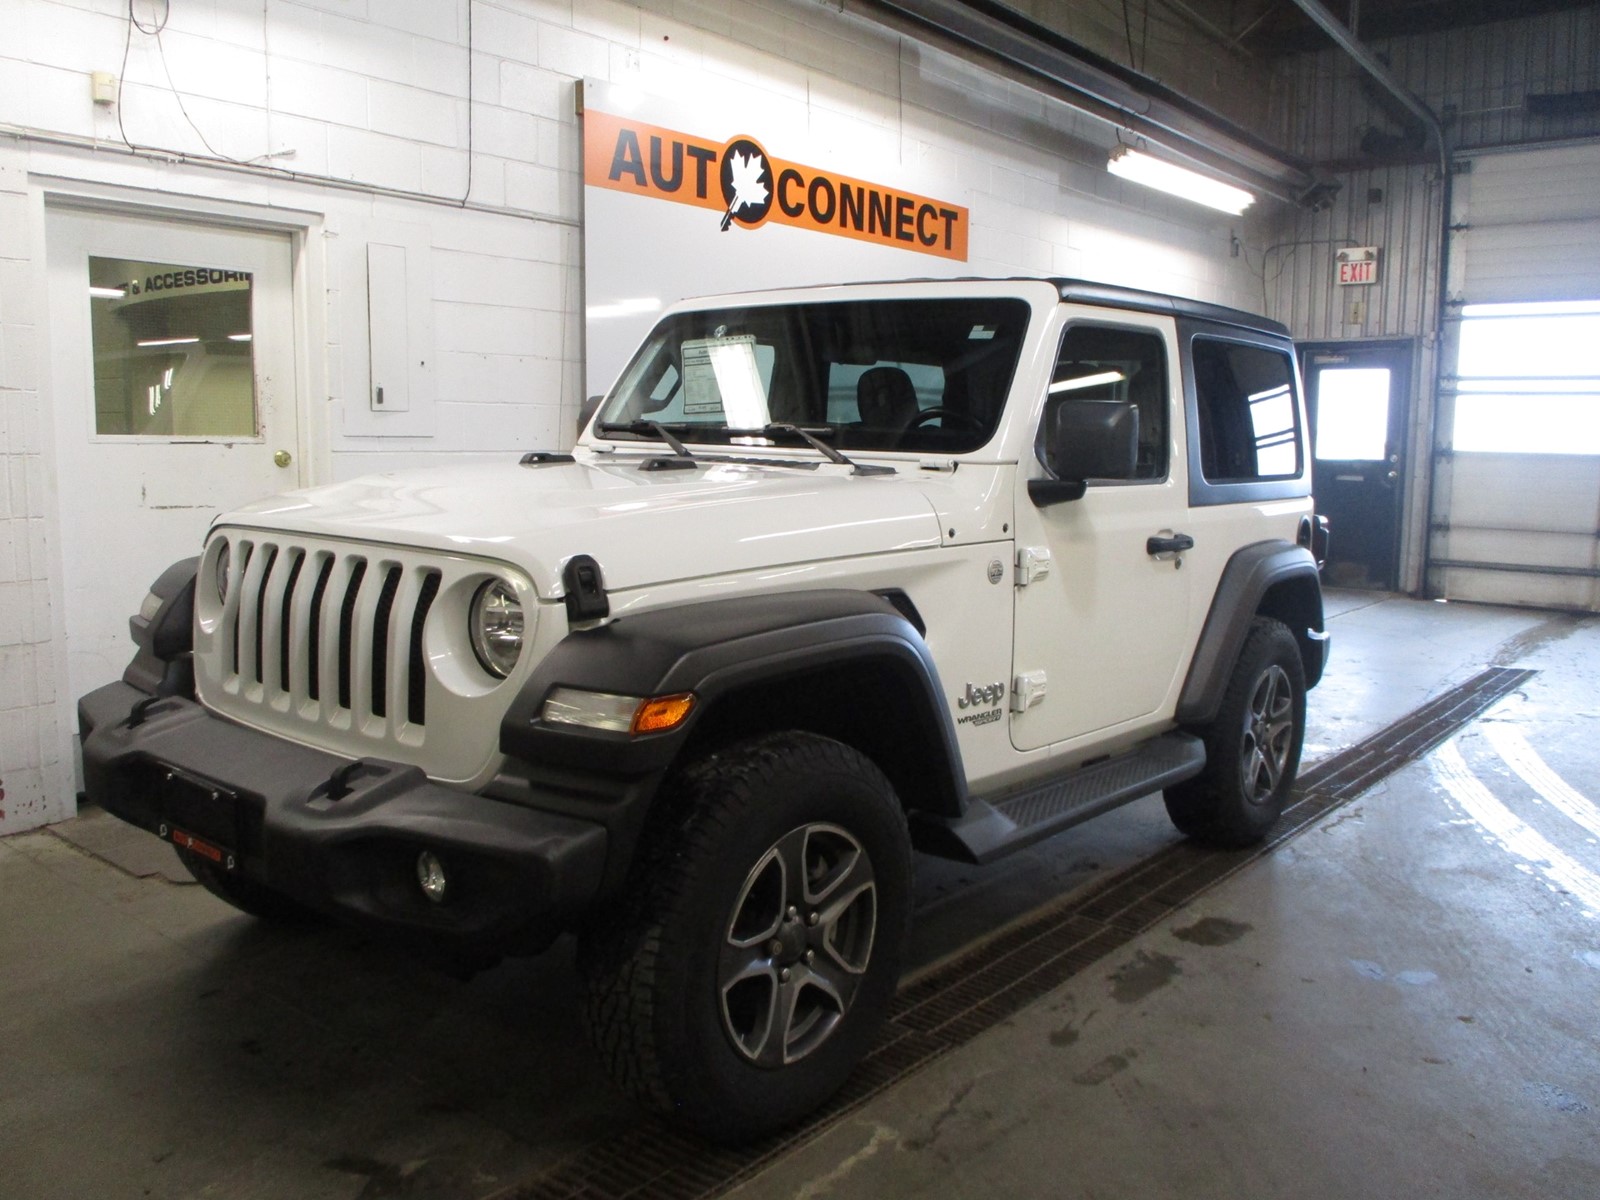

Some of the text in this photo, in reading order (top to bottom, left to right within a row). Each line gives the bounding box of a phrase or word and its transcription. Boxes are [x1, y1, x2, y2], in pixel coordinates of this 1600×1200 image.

[1340, 262, 1372, 283] EXIT
[958, 682, 1005, 709] Jeep
[957, 708, 1002, 725] WRANGLER
